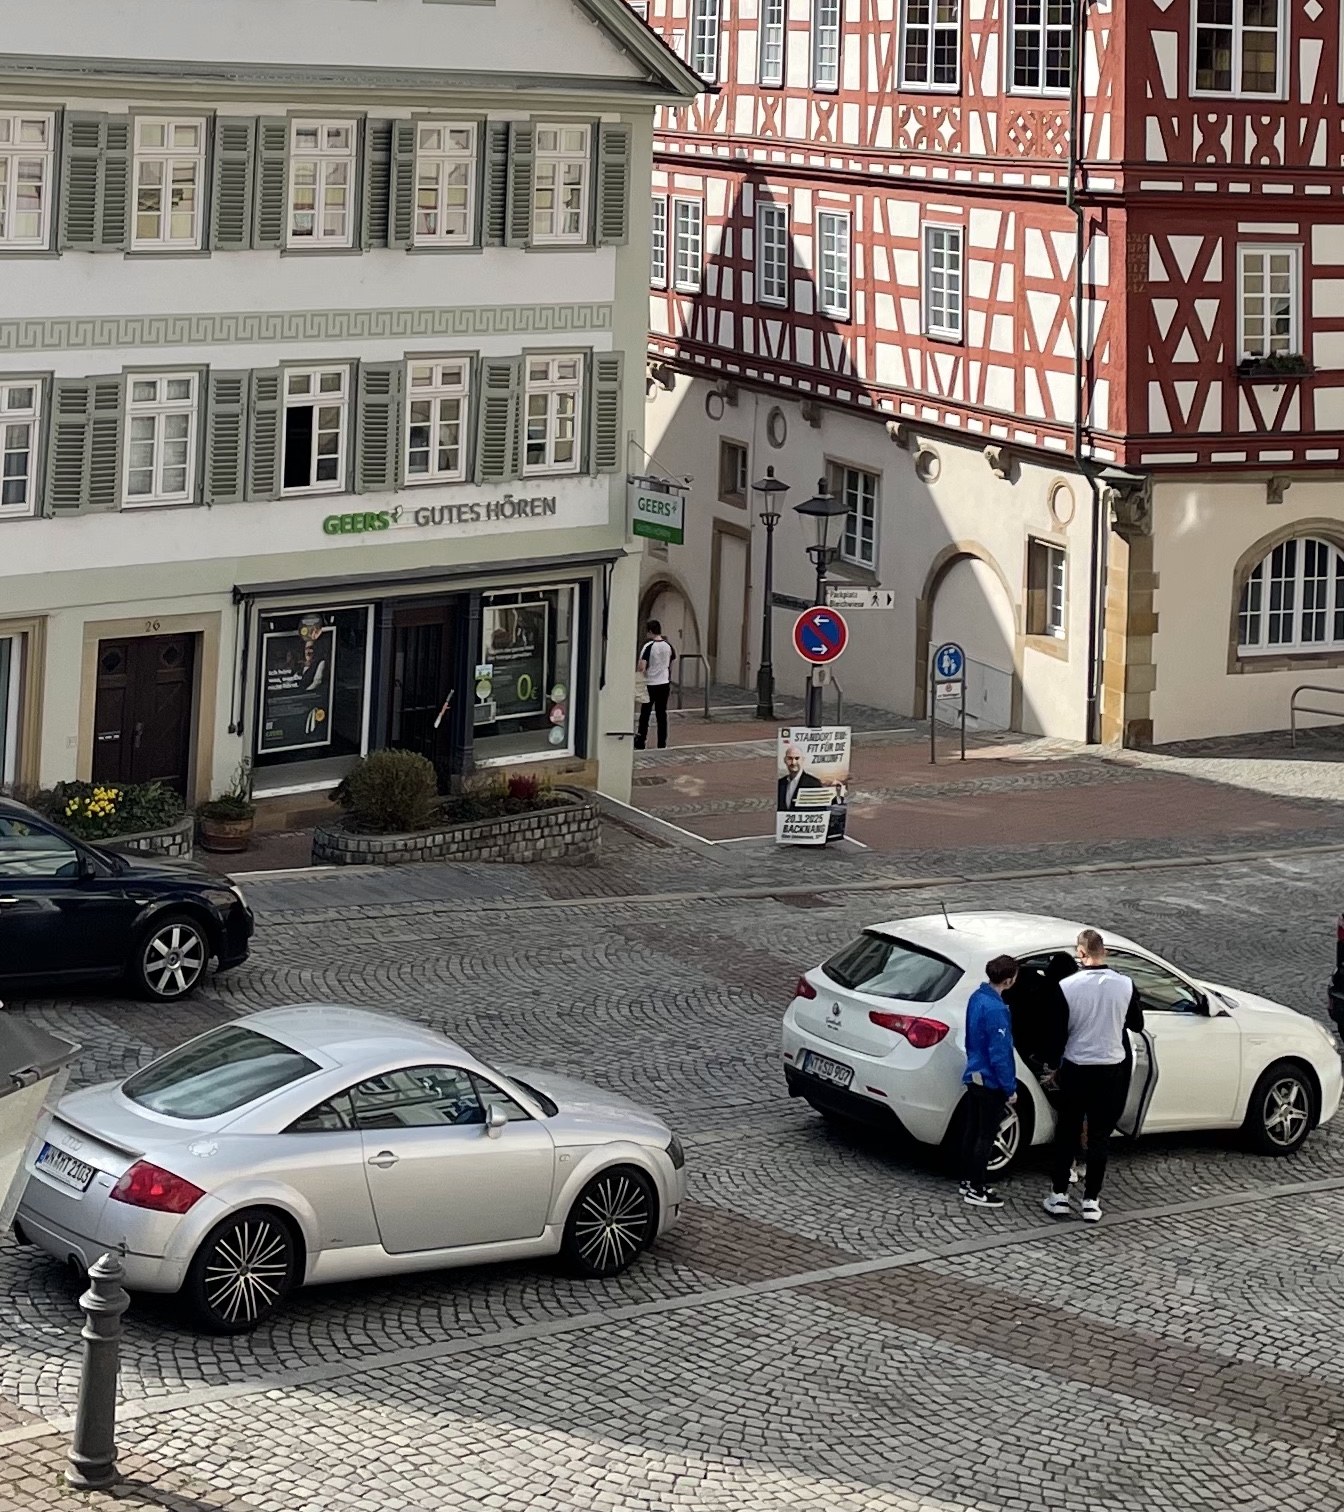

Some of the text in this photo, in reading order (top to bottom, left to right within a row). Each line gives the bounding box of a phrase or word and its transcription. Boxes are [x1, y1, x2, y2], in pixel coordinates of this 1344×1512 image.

[638, 497, 671, 516] GEERS
[323, 494, 557, 536] GEERS GUTES HÖREN
[145, 619, 161, 632] 26
[794, 732, 833, 742] STANDORT
[806, 742, 846, 753] FIT FÜR DIE
[811, 753, 844, 764] ZUKUNFT
[782, 824, 826, 834] BACKNANG
[834, 1065, 850, 1083] 907
[67, 1160, 91, 1184] 2103
